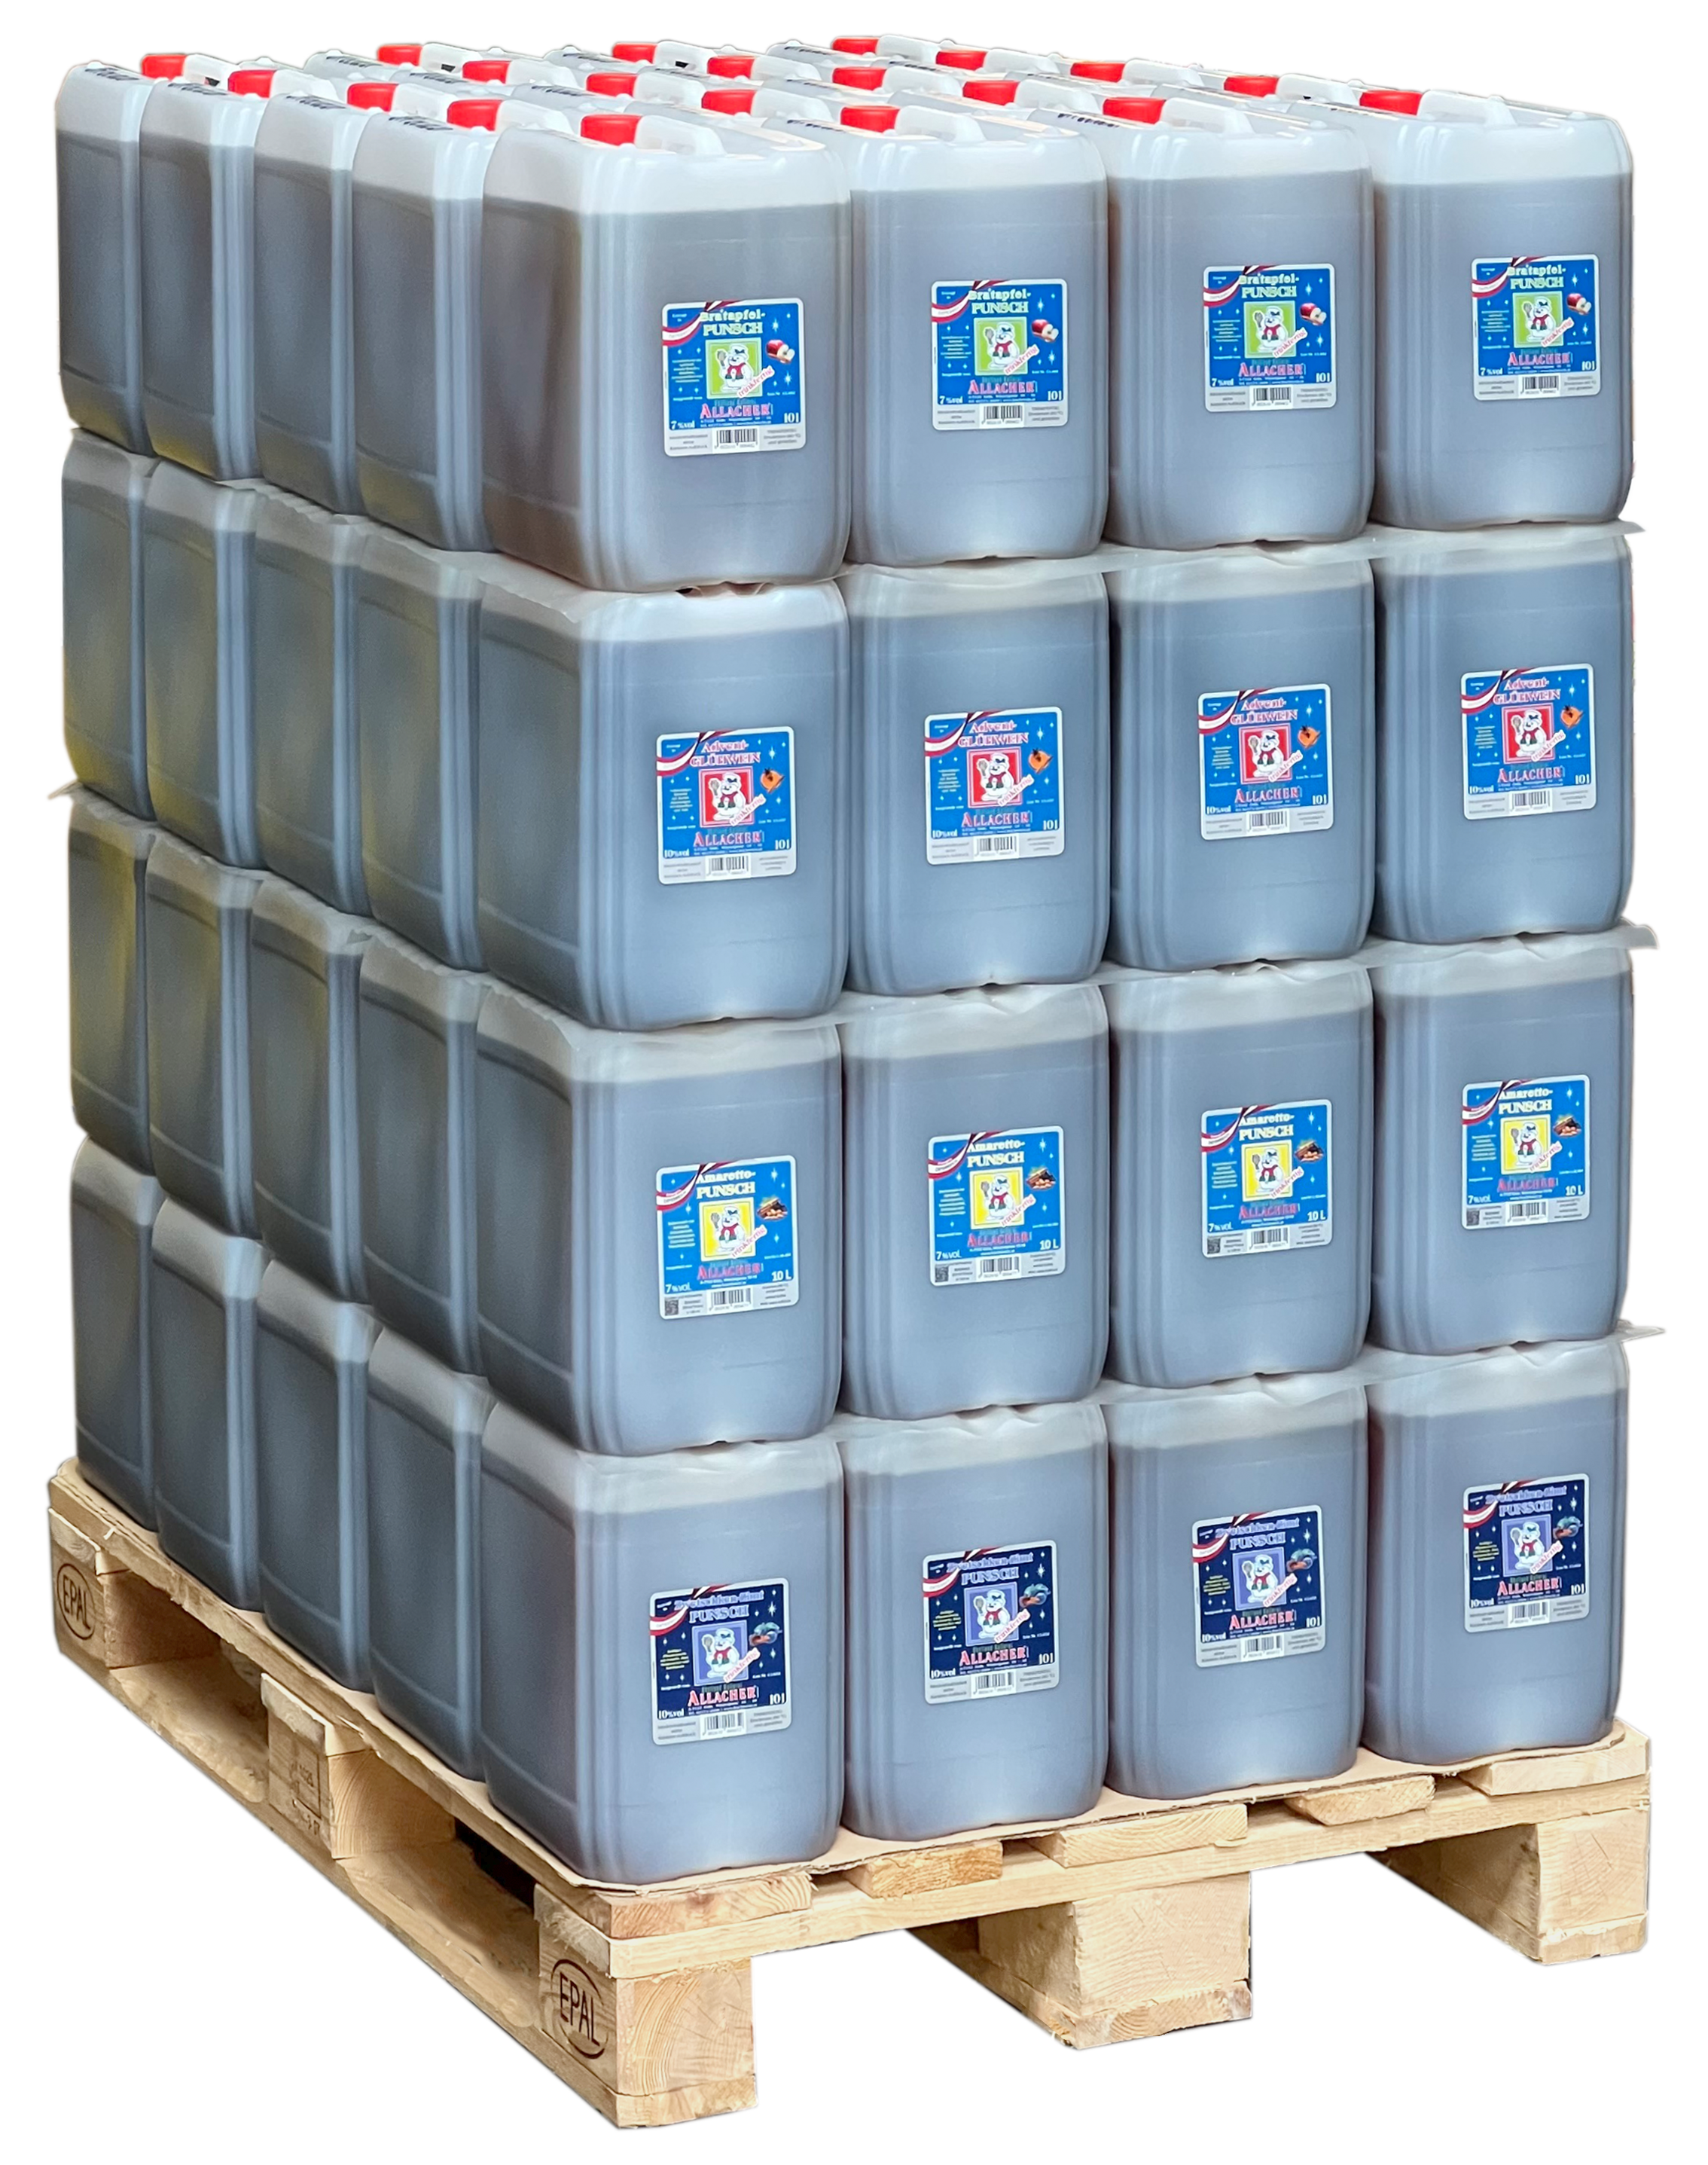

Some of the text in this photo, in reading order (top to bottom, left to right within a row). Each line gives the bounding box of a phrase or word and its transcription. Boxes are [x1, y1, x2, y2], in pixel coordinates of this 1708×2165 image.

[1511, 276, 1564, 289] PUNSCH
[1242, 286, 1297, 298] PUNSCH
[971, 301, 1029, 314] PUNSCH
[703, 322, 763, 336] PUNSCH
[1508, 352, 1570, 365] ALLACHER
[1239, 362, 1304, 377] ALLACHER
[968, 380, 1035, 395] ALLACHER
[1212, 378, 1217, 386] 7
[700, 402, 771, 419] ALLACHER
[1504, 676, 1549, 691] Advent-
[1241, 697, 1286, 711] Advent-
[969, 719, 1017, 734] Advent-
[701, 739, 749, 753] Advent-
[1498, 766, 1562, 783] ALLACHER
[1235, 787, 1299, 803] ALLACHER
[962, 811, 1029, 828] ALLACHER
[694, 831, 761, 847] ALLACHER
[1498, 1088, 1553, 1100] Amaretto-
[1499, 1099, 1552, 1114] PUNSCH
[1238, 1113, 1295, 1126] Amaretto-
[1239, 1125, 1294, 1141] PUNSCH
[967, 1140, 1025, 1153] Amaretto-
[967, 1151, 1025, 1168] PUNSCH
[696, 1170, 756, 1183] Amaretto-
[697, 1181, 755, 1199] PUNSCH
[1566, 1185, 1583, 1195] 10 L
[1307, 1210, 1325, 1221] 10 L
[1209, 1223, 1214, 1232] 7
[1040, 1239, 1059, 1250] 10 L
[936, 1251, 942, 1260] 7
[771, 1270, 791, 1281] 10 L
[666, 1284, 672, 1293] 7
[1499, 1499, 1553, 1517] PUNSCH
[1230, 1532, 1286, 1550] PUNSCH
[962, 1567, 1019, 1585] PUNSCH
[1497, 1577, 1559, 1596] ALLACHER
[63, 1574, 90, 1630] EPAL
[689, 1605, 749, 1623] PUNSCH
[1230, 1611, 1293, 1630] ALLACHER
[959, 1647, 1026, 1666] ALLACHER
[688, 1687, 756, 1707] ALLACHER
[560, 1971, 600, 2047] EPAL
